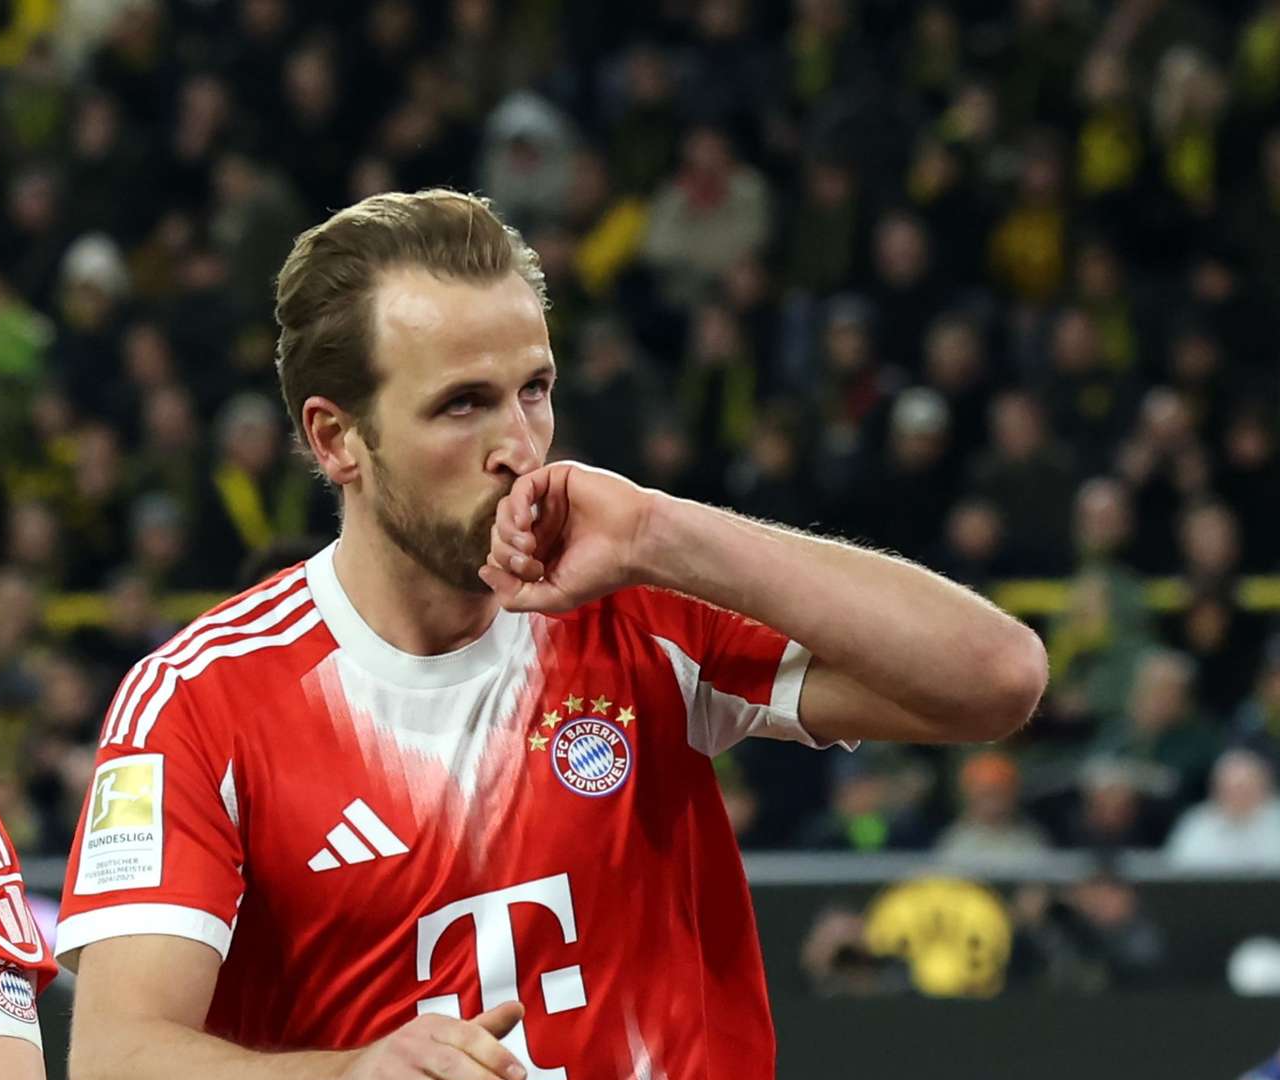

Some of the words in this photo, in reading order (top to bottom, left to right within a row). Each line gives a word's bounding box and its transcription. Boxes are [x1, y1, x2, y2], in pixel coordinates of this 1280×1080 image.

[556, 739, 569, 758] FC
[565, 723, 619, 746] BAYERN
[88, 832, 154, 849] BUNDESLIGA
